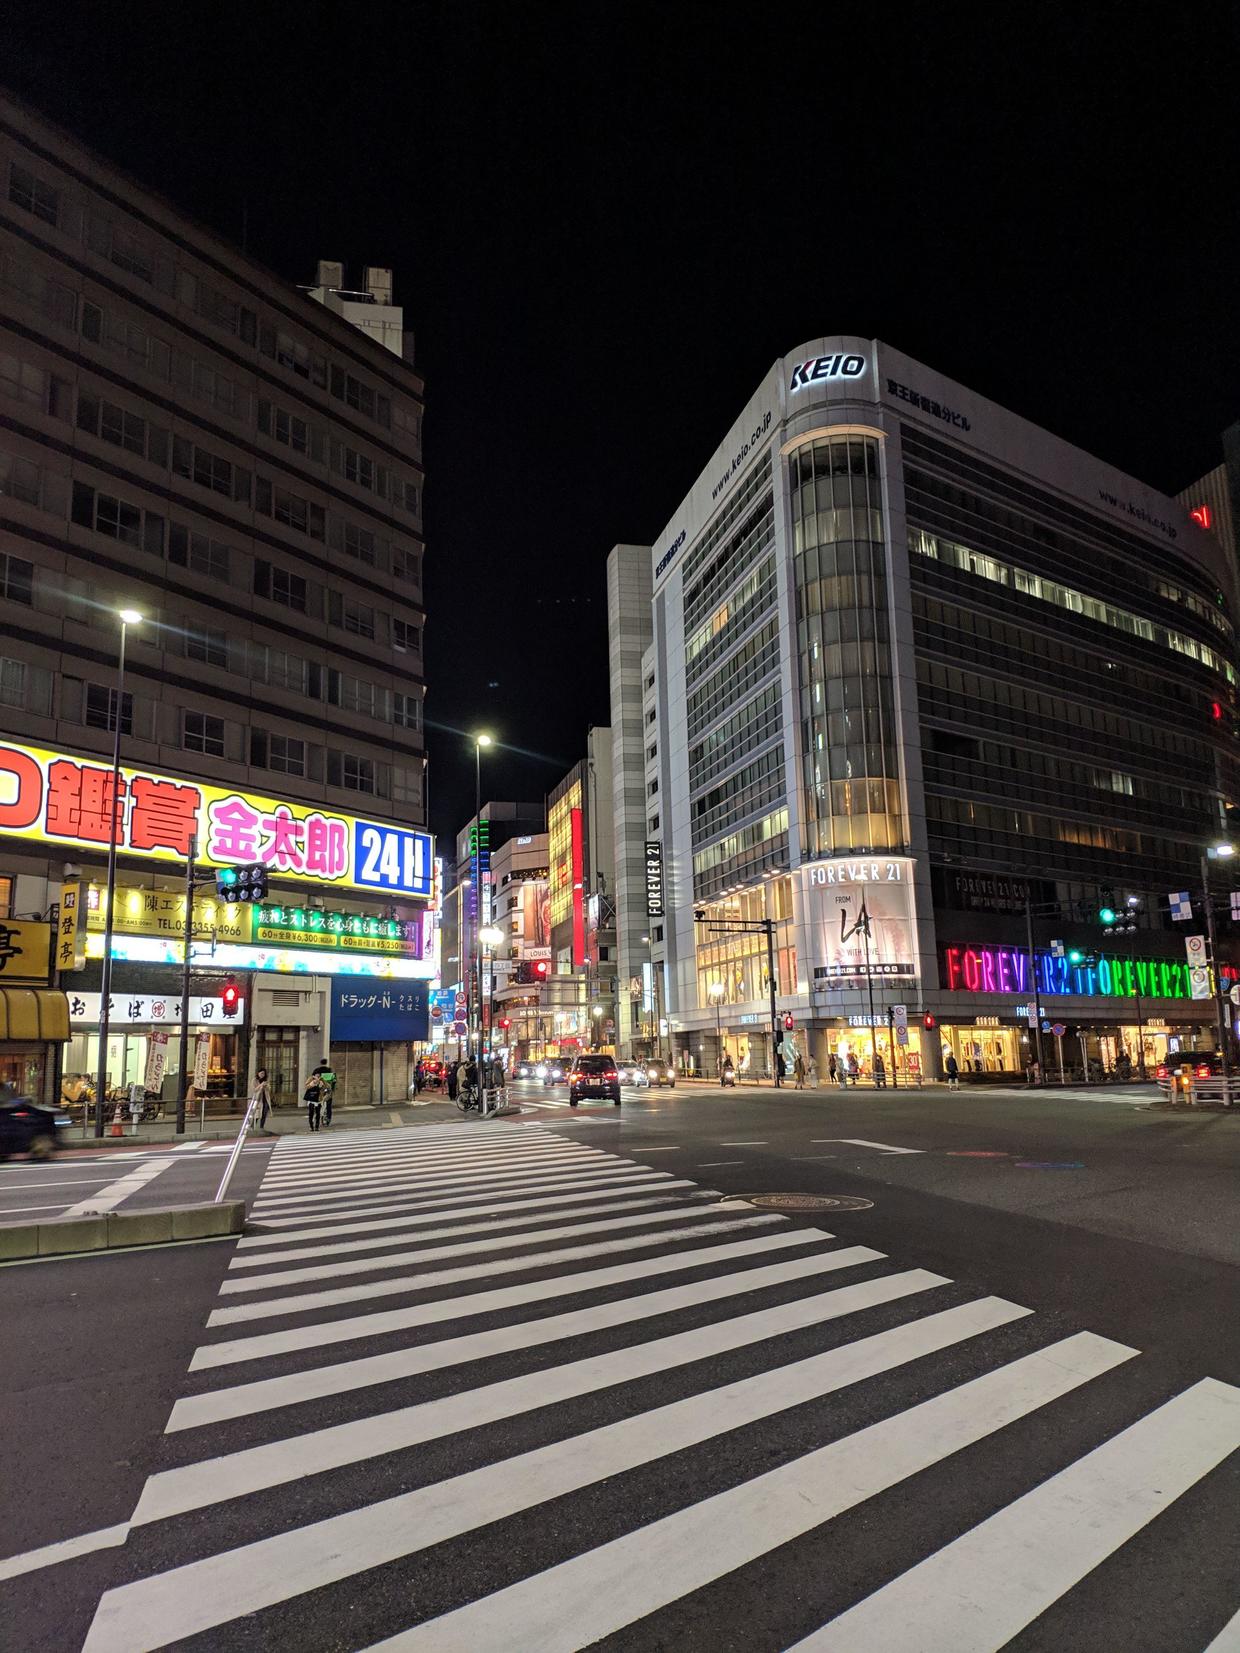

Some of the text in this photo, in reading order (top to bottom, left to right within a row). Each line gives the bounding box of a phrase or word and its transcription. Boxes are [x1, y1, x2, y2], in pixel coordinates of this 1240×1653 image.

[790, 355, 865, 390] KEIO
[712, 411, 772, 500] www.keio.co.jp
[213, 801, 345, 874] 金太郎
[647, 844, 661, 914] FOREVER 21
[811, 863, 901, 885] FOREVER 21
[835, 895, 851, 904] FROM
[157, 918, 241, 936] TEL.033355-4966
[530, 949, 547, 957] LOUIS
[848, 1015, 882, 1026] FOREVER
